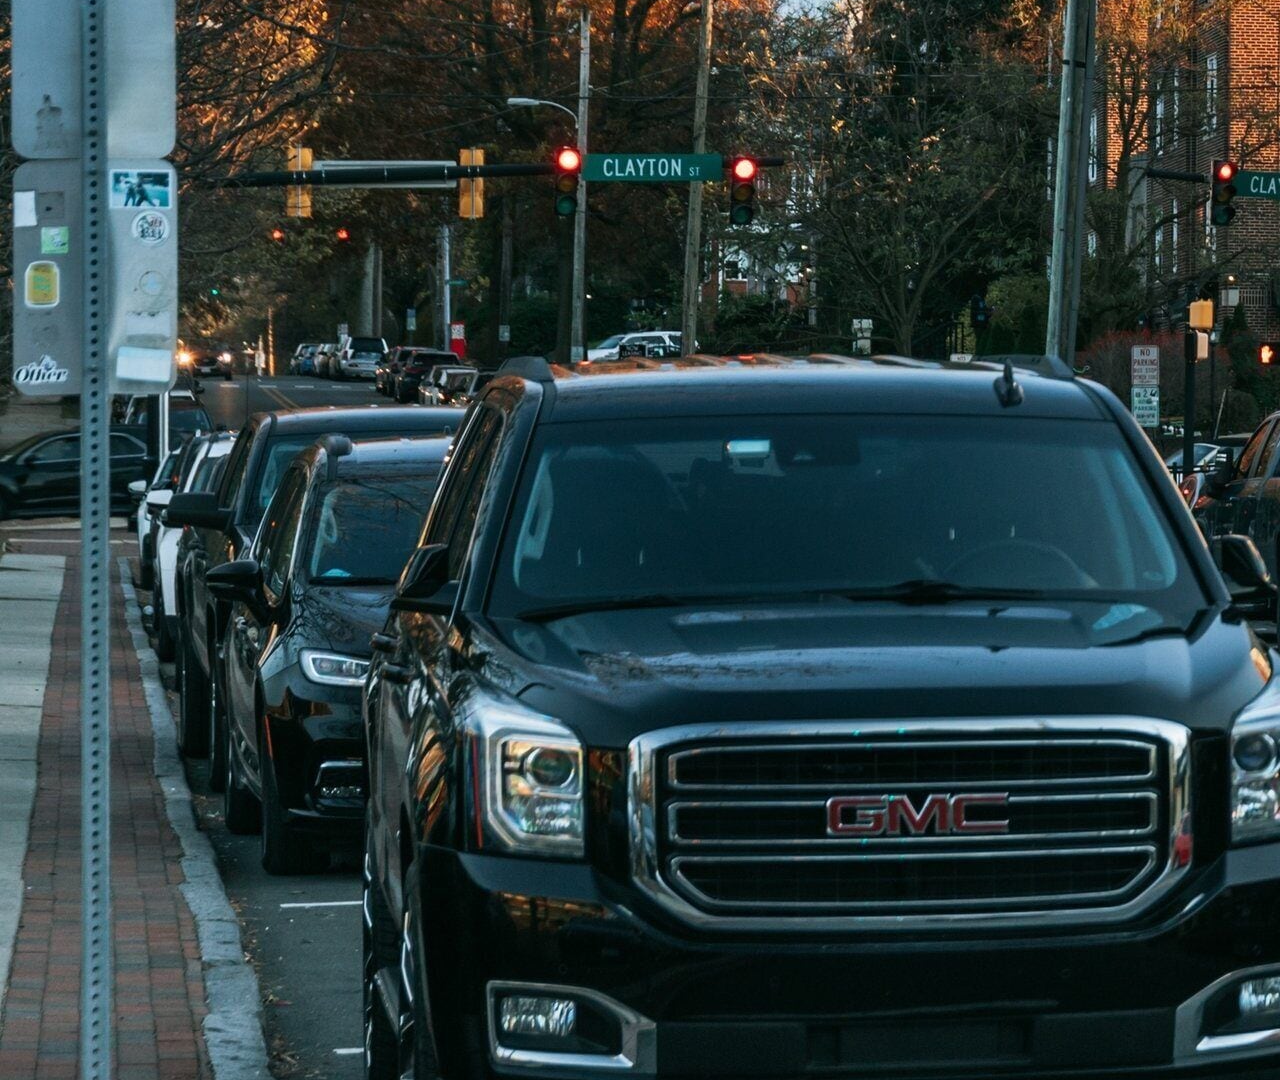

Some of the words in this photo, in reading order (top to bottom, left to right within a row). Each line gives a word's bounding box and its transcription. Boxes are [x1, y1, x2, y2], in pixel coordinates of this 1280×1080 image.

[602, 158, 682, 177] CLAYTON
[689, 166, 701, 176] ST
[1140, 348, 1151, 356] NO
[1134, 358, 1158, 367] PARKING
[826, 792, 1010, 836] GMC
